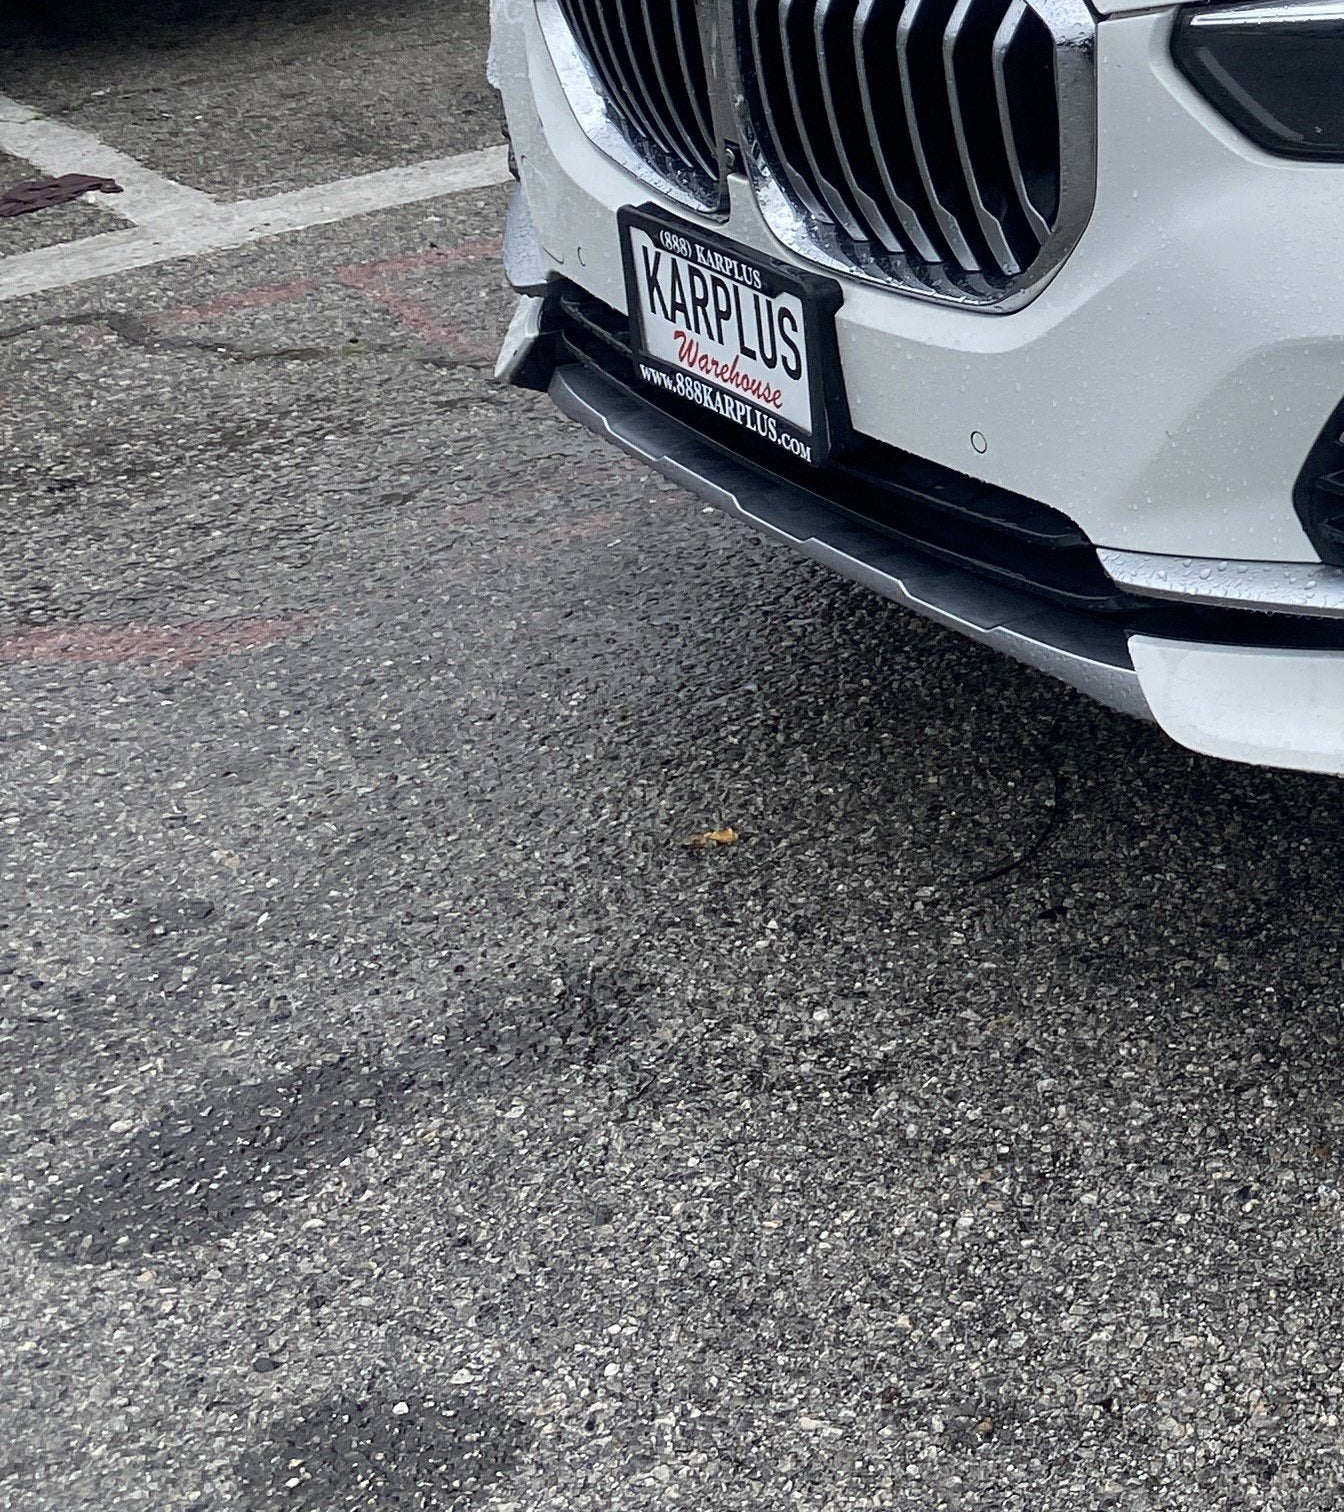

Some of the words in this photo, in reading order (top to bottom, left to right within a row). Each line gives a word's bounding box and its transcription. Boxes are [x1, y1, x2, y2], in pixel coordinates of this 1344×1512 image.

[659, 229, 692, 258] (888)
[694, 243, 762, 289] KARPLUS
[641, 245, 803, 381] KARPLUS
[673, 330, 783, 409] Warehouse
